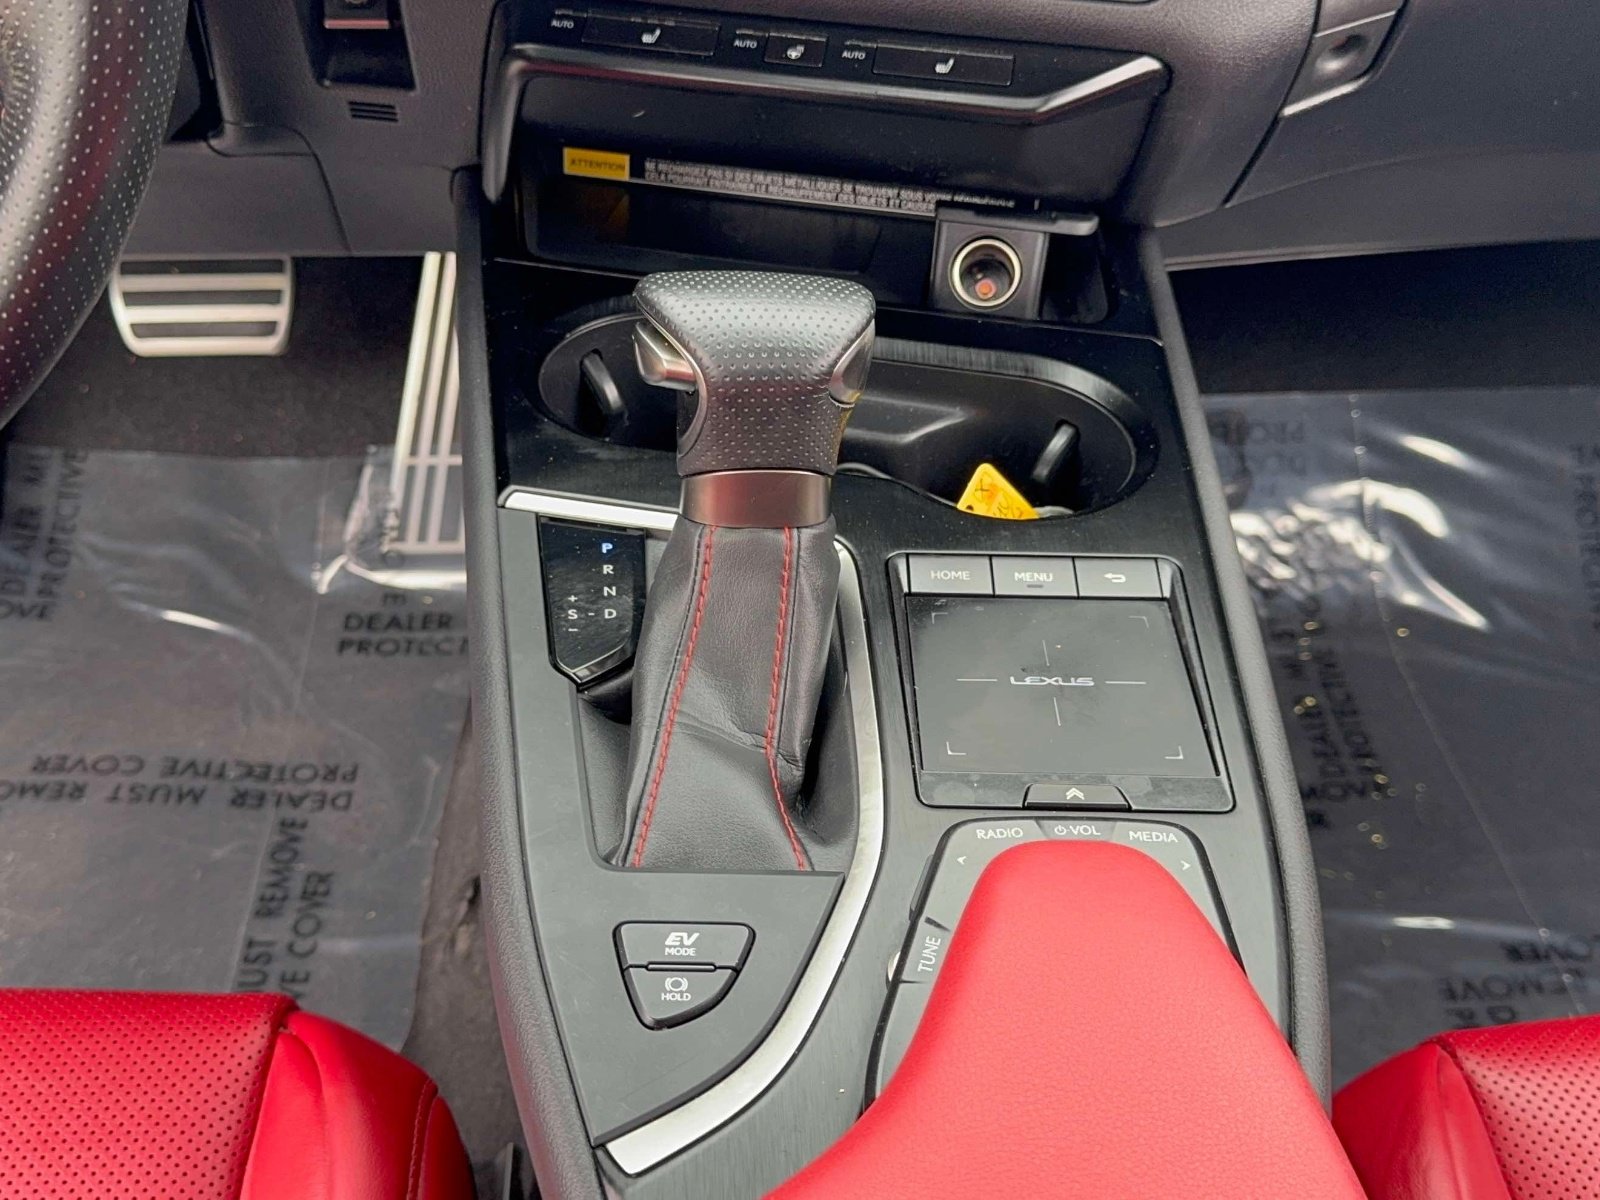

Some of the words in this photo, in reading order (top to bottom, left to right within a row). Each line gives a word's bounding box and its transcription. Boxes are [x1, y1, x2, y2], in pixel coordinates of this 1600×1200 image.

[551, 19, 574, 29] AUTO
[733, 39, 757, 49] AUTO
[841, 50, 866, 61] AUTO
[571, 158, 626, 172] ATTENTION
[602, 543, 613, 553] P
[603, 565, 614, 575] R
[930, 570, 970, 581] HOME
[1014, 572, 1053, 582] MENU
[603, 586, 616, 597] N
[568, 609, 578, 620] S
[604, 609, 617, 619] D
[343, 611, 453, 631] DEALER
[1009, 676, 1095, 686] LEXUS
[31, 753, 146, 775] COVER
[161, 755, 358, 785] PROTECTIVE
[106, 783, 206, 808] MUST
[230, 786, 354, 812] DEALER
[976, 827, 1024, 840] RADIO
[1071, 825, 1101, 836] VOL
[1129, 831, 1178, 843] MEDIA
[255, 817, 308, 919] REMOVE
[287, 871, 335, 958] COVER
[664, 932, 700, 946] EV
[664, 947, 696, 957] MODE
[917, 935, 941, 972] TUNE
[661, 992, 691, 1001] HOLD
